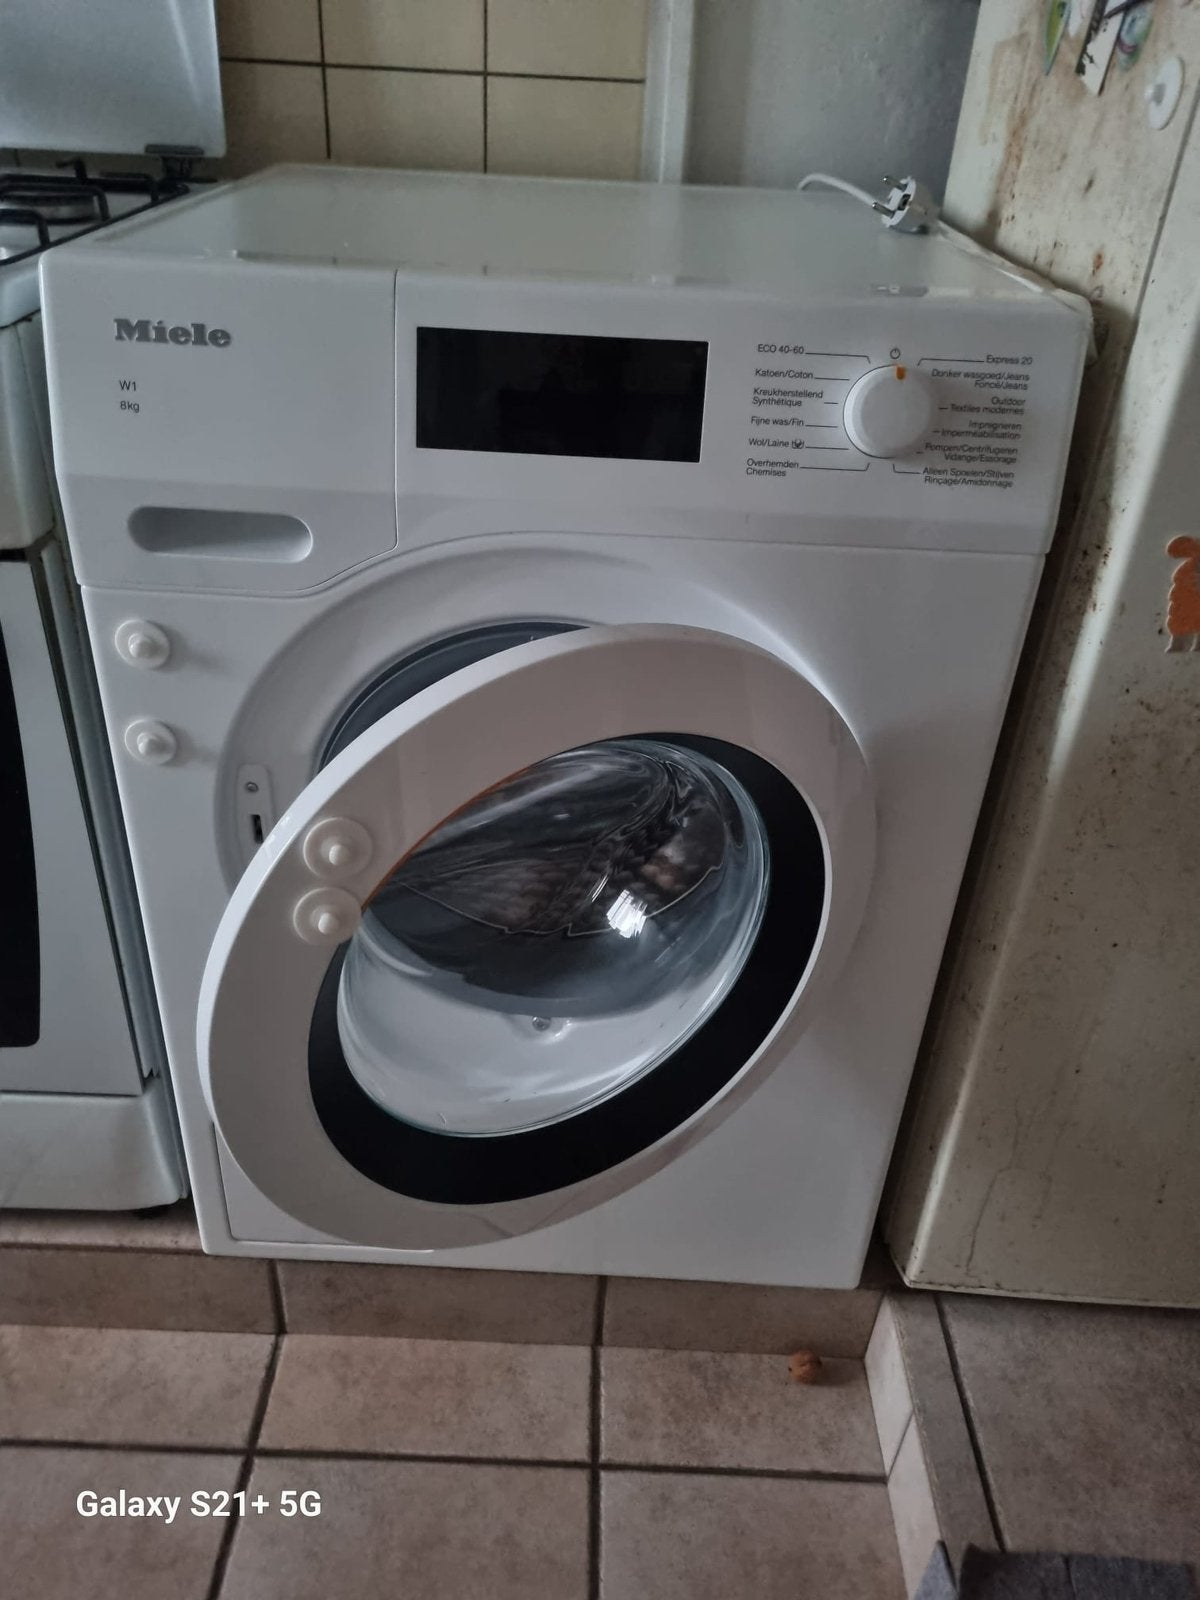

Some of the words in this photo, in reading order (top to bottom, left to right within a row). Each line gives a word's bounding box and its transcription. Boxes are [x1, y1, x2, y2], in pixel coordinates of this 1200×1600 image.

[113, 318, 232, 348] Miele
[757, 343, 777, 353] ECO
[778, 345, 805, 355] 40-60
[986, 354, 1019, 365] Express
[1020, 356, 1033, 365] 20
[755, 368, 814, 379] Katoen/Coton
[931, 368, 961, 378] Donker
[119, 379, 137, 391] W1
[753, 387, 824, 399] Kreukherstellend
[120, 400, 140, 413] 8kg
[752, 397, 802, 410] Synthétique
[991, 396, 1026, 406] Outdoor
[951, 403, 980, 413] Textiles
[982, 406, 1025, 415] modernes
[751, 415, 771, 427] Fijne
[772, 417, 805, 426] was/Fin
[748, 438, 789, 447] Wol/Laine
[925, 442, 1018, 456] Pompen/Centrifugeren
[746, 458, 799, 469] Overhemden
[944, 452, 1017, 465] Vidange/Essorage
[746, 467, 786, 477] Chemises
[922, 466, 948, 476] Alleen
[924, 475, 1014, 489] Rinçage/Amidonnage
